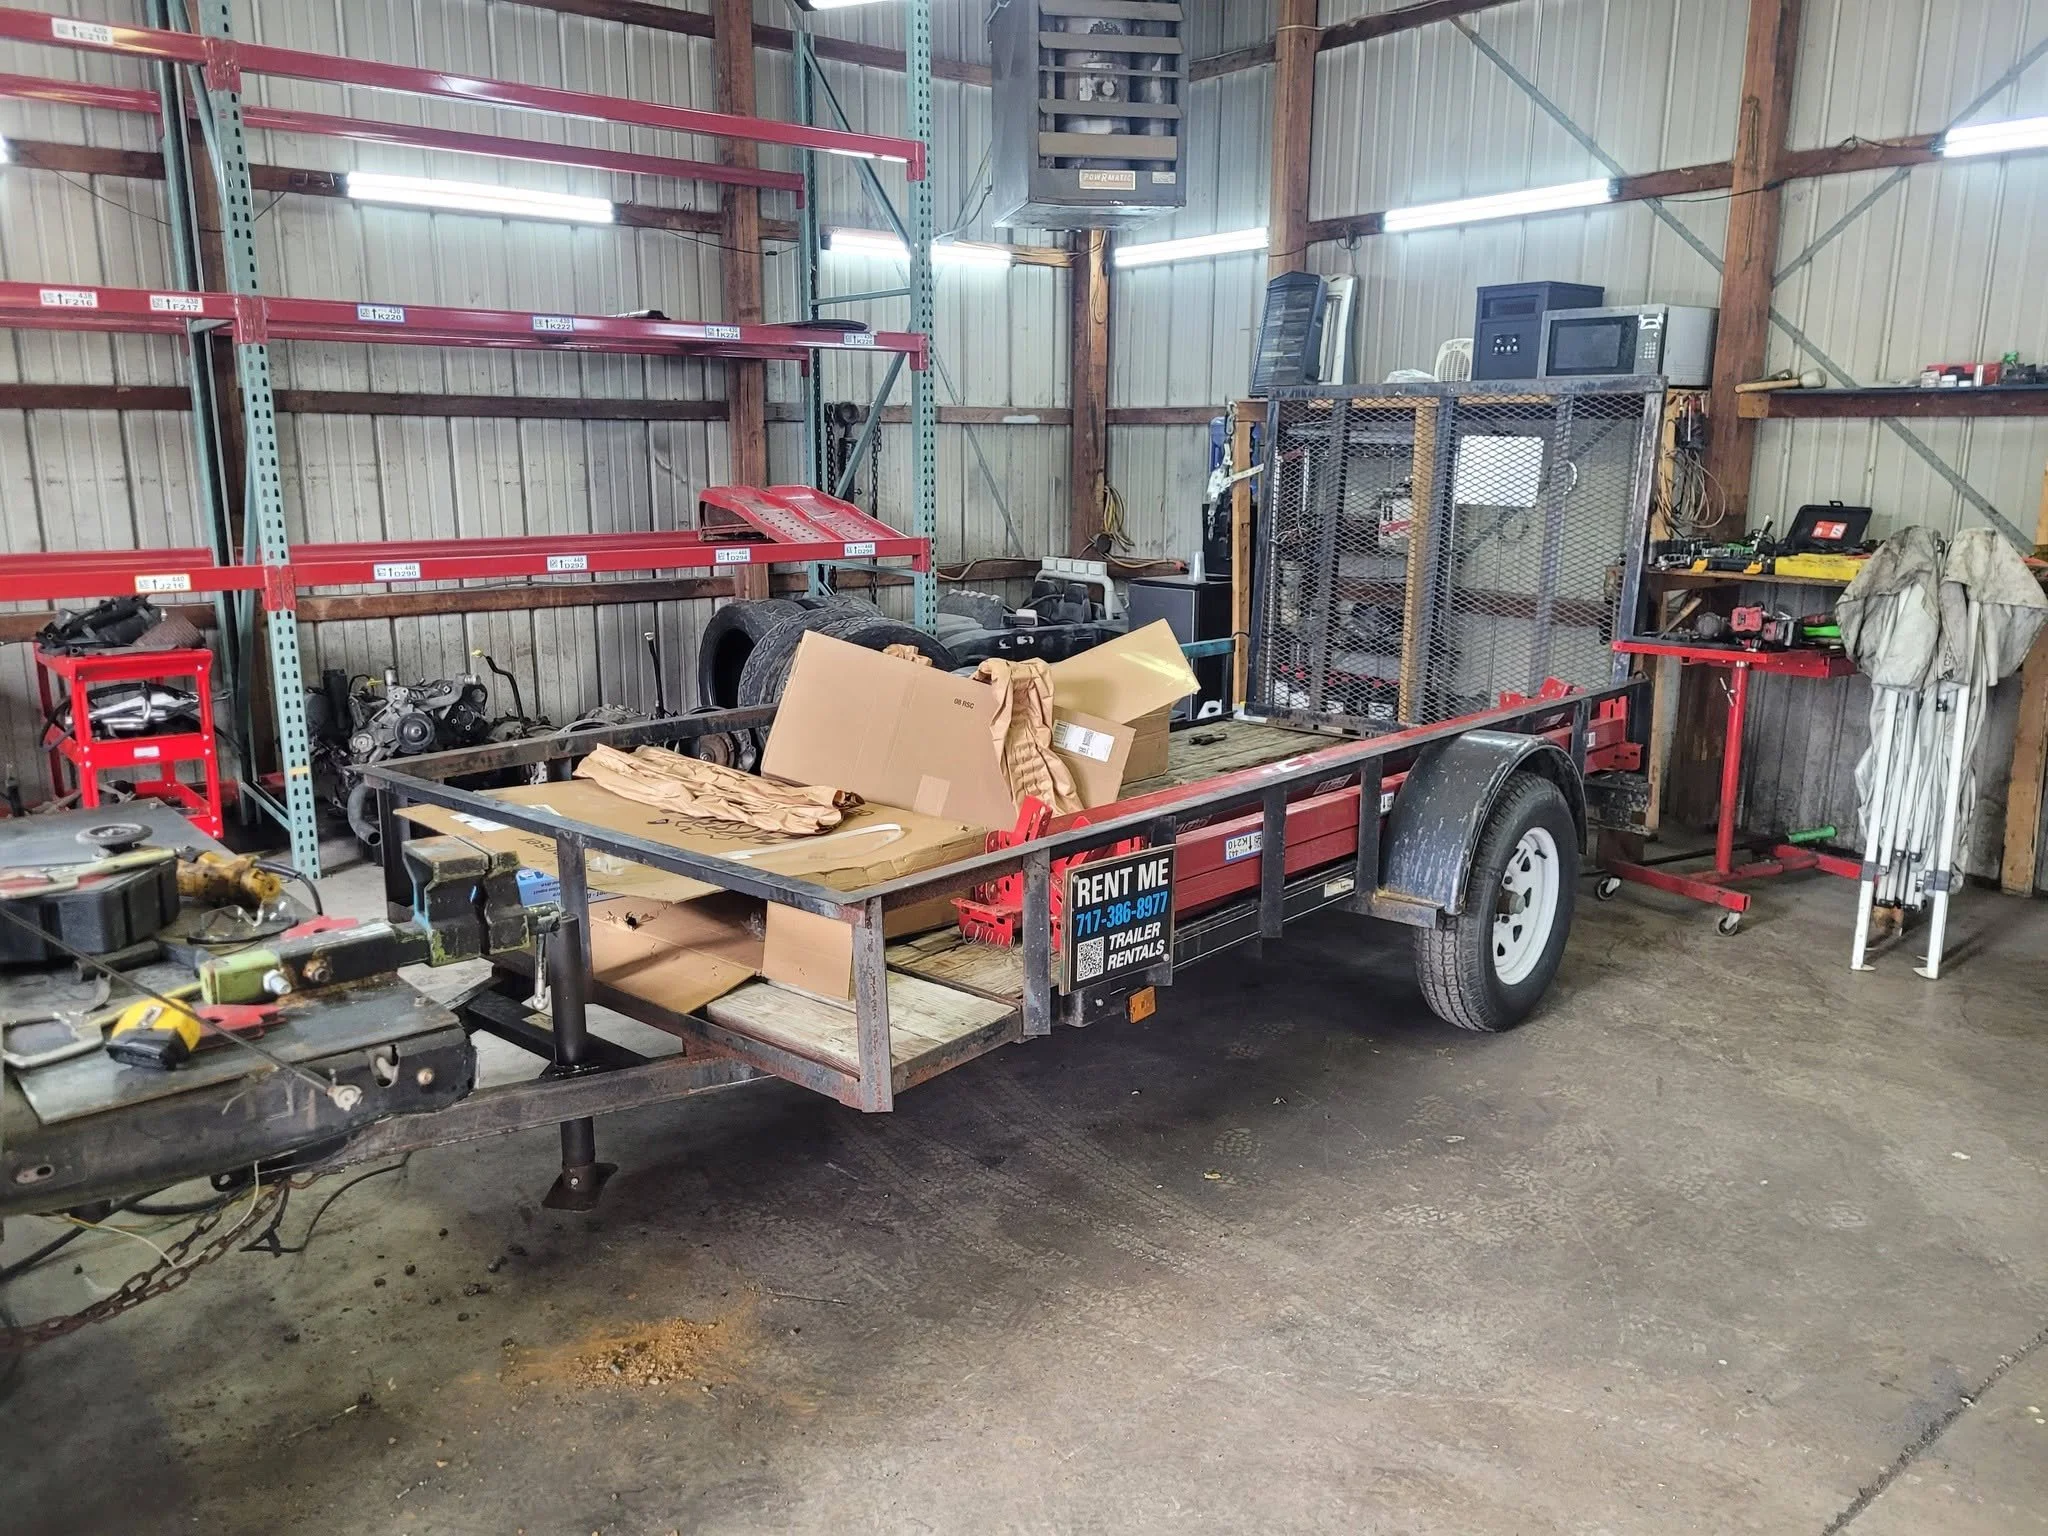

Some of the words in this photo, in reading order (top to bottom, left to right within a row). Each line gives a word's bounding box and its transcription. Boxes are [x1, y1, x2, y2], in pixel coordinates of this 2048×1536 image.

[65, 298, 93, 306] F216
[172, 303, 198, 311] F217
[378, 313, 402, 321] K220
[1228, 837, 1248, 849] K210
[1077, 866, 1133, 908] RENT
[1137, 857, 1169, 892] ME
[1076, 890, 1168, 937] 717-386-8977
[1109, 921, 1161, 951] TRAILER
[1107, 939, 1165, 971] RENTALS
